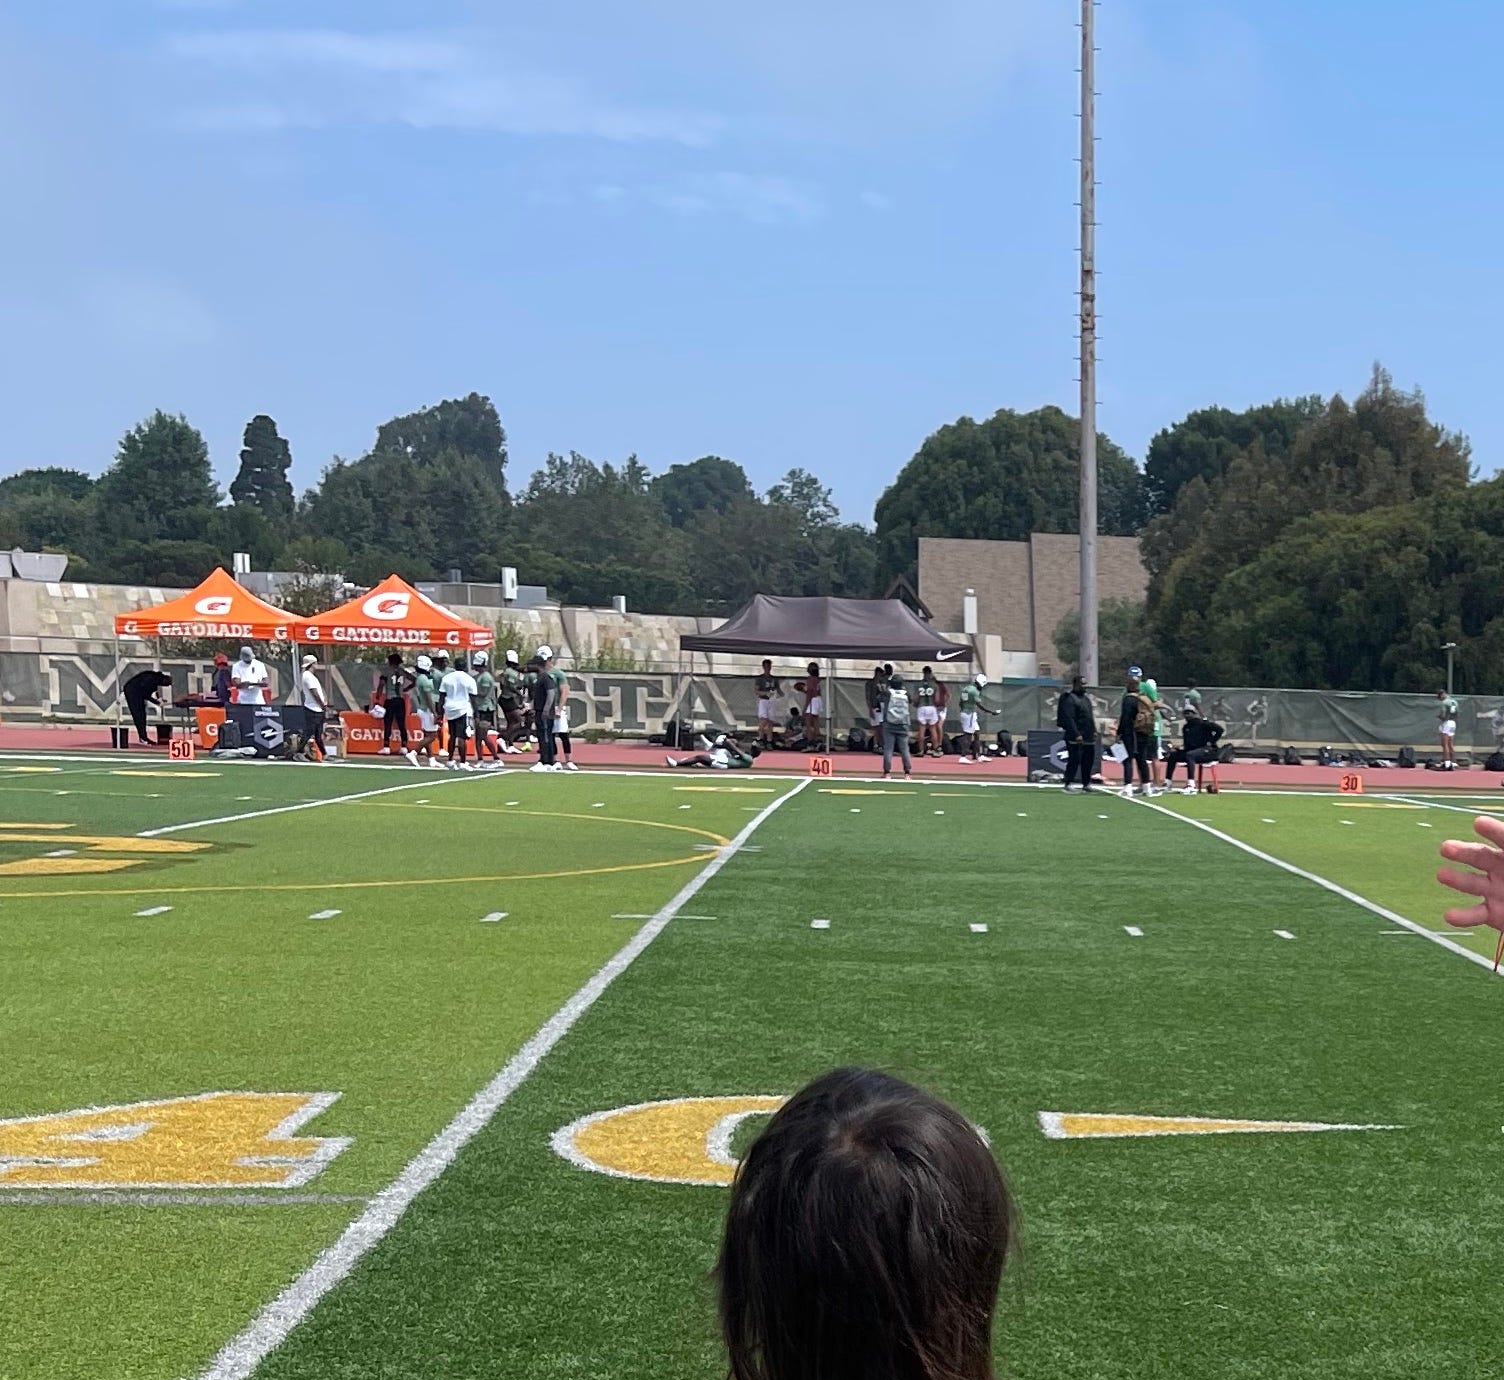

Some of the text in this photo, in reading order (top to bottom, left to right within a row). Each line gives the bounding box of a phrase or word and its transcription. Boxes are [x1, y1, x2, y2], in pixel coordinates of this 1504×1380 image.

[158, 622, 253, 638] GATORADE
[332, 627, 430, 644] GATORADE
[350, 728, 424, 742] GATRAD
[171, 741, 190, 758] 50
[812, 759, 830, 775] 40
[1342, 775, 1358, 790] 30
